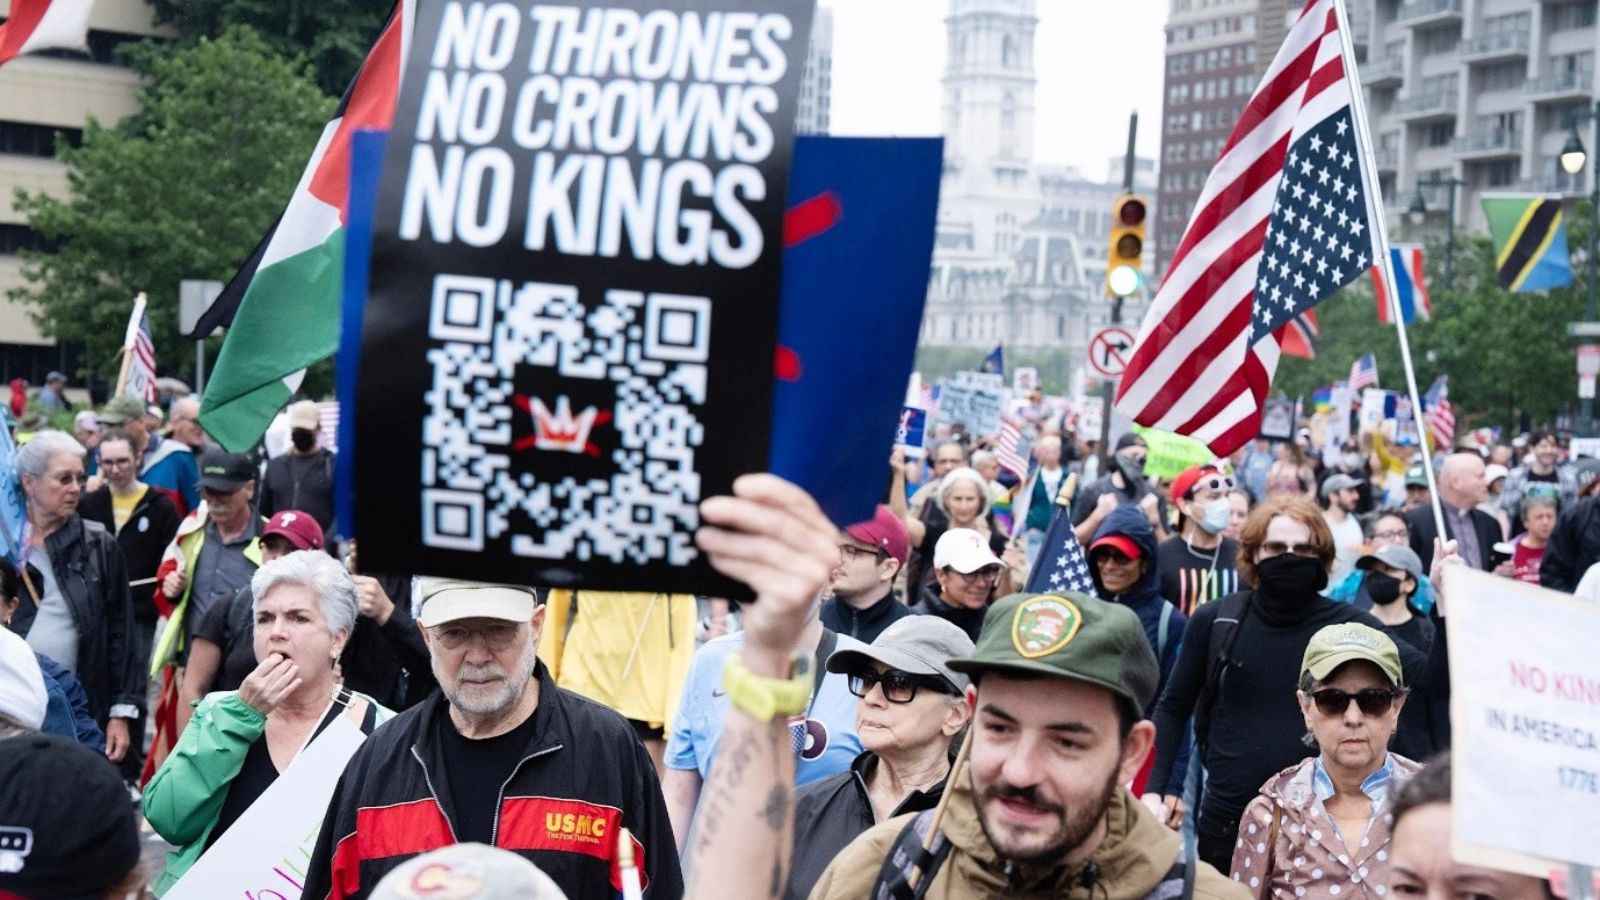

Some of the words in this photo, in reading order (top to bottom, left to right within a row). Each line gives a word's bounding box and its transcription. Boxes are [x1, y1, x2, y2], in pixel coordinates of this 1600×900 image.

[431, 1, 521, 71] NO
[529, 5, 793, 85] THRONES
[416, 70, 507, 145] NO
[511, 74, 779, 163] CROWNS
[398, 143, 515, 247] NO
[524, 151, 766, 269] KINGS
[1508, 660, 1547, 694] NO
[1553, 671, 1600, 705] KIN
[1486, 707, 1507, 731] IN
[546, 812, 606, 837] USMC
